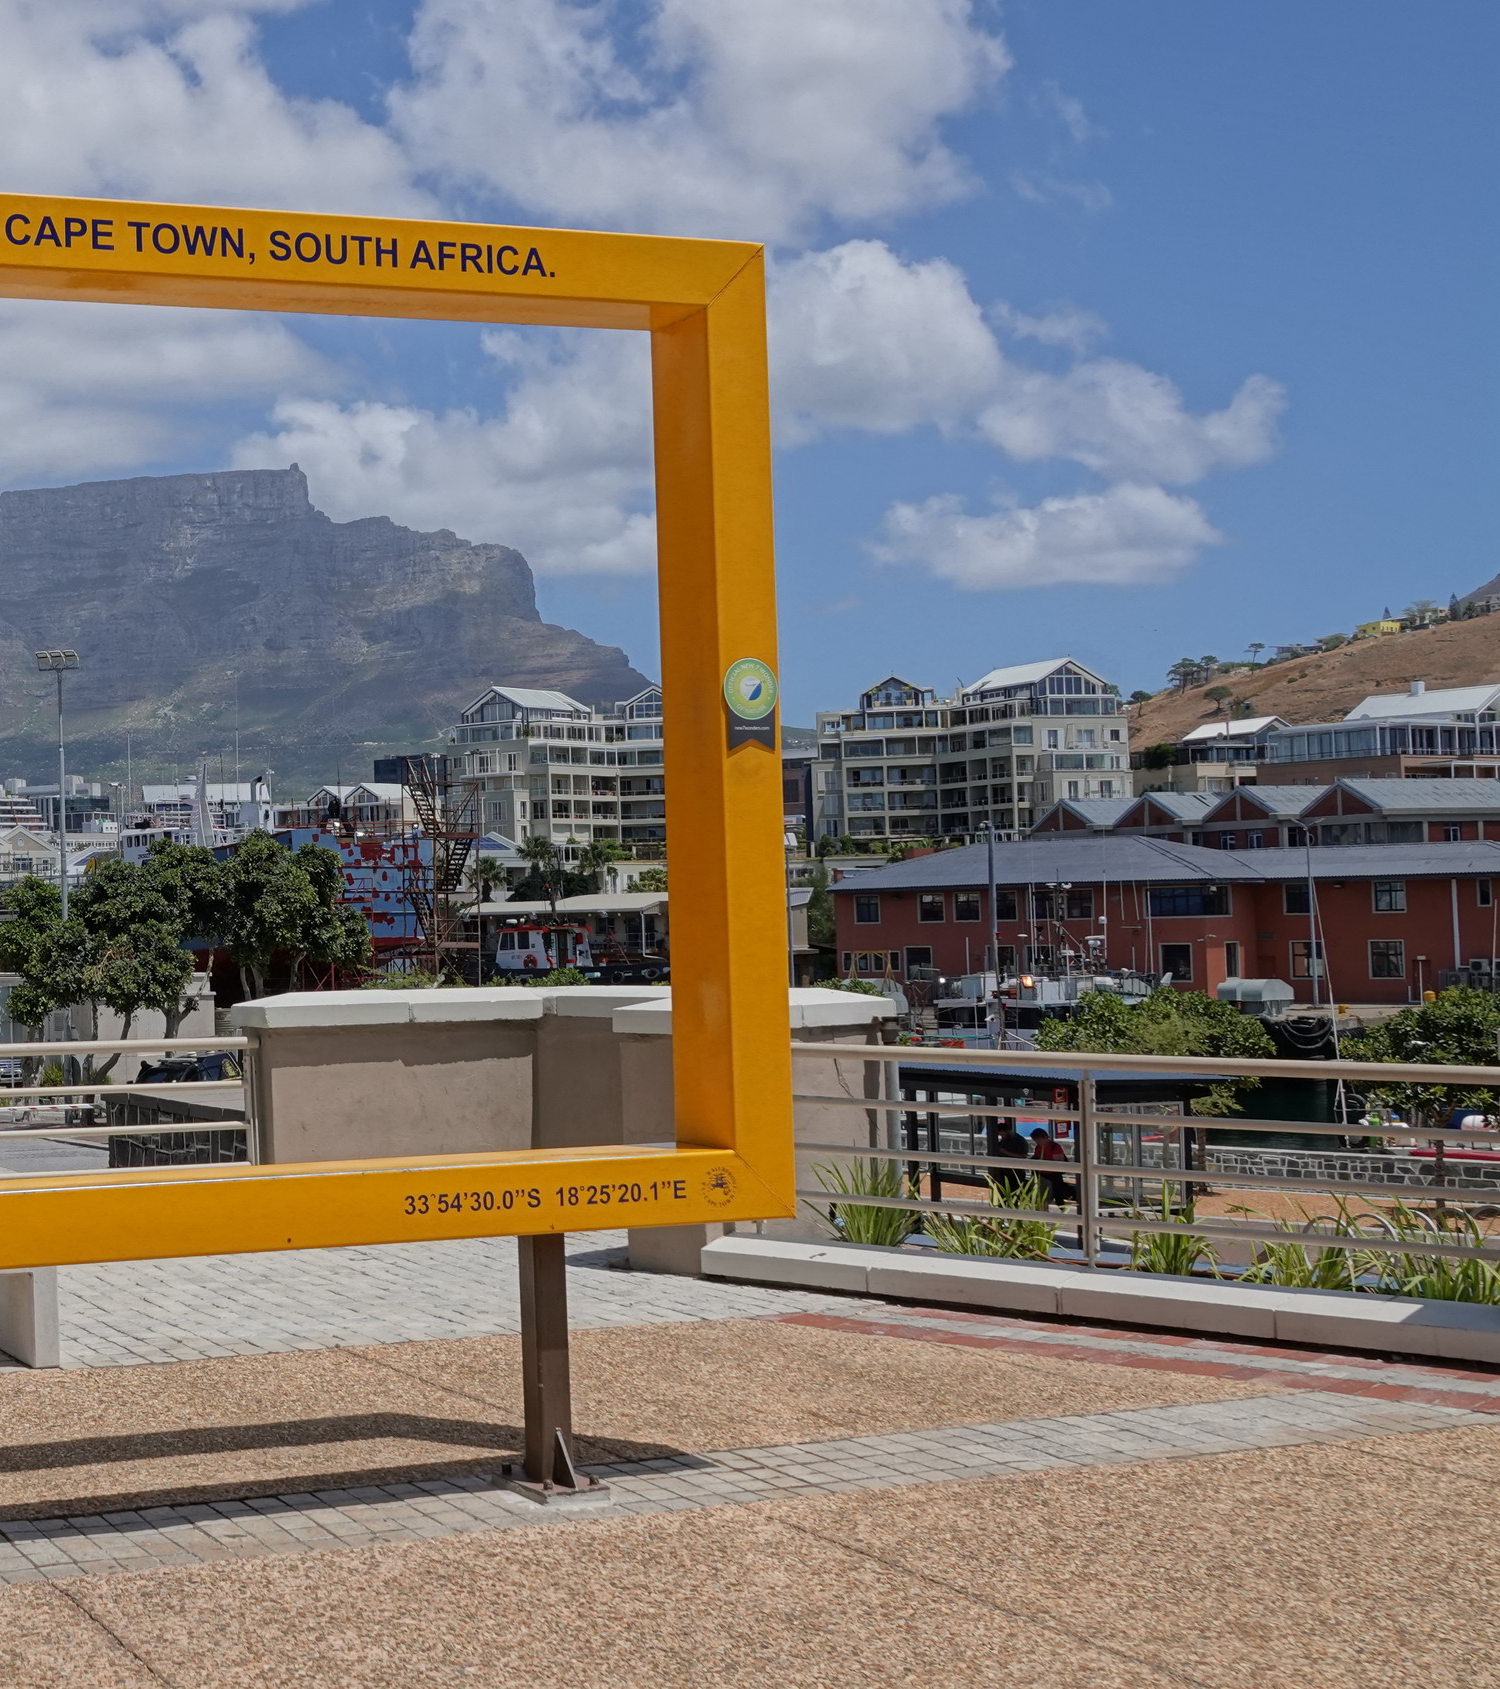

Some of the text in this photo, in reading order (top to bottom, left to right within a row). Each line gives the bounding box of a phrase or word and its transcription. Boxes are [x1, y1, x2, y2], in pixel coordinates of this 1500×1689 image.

[4, 213, 115, 251] CAPE
[127, 221, 256, 265] TOWN,
[268, 230, 399, 268] SOUTH
[409, 239, 557, 278] AFRICA.
[728, 667, 741, 694] OFFICIAL
